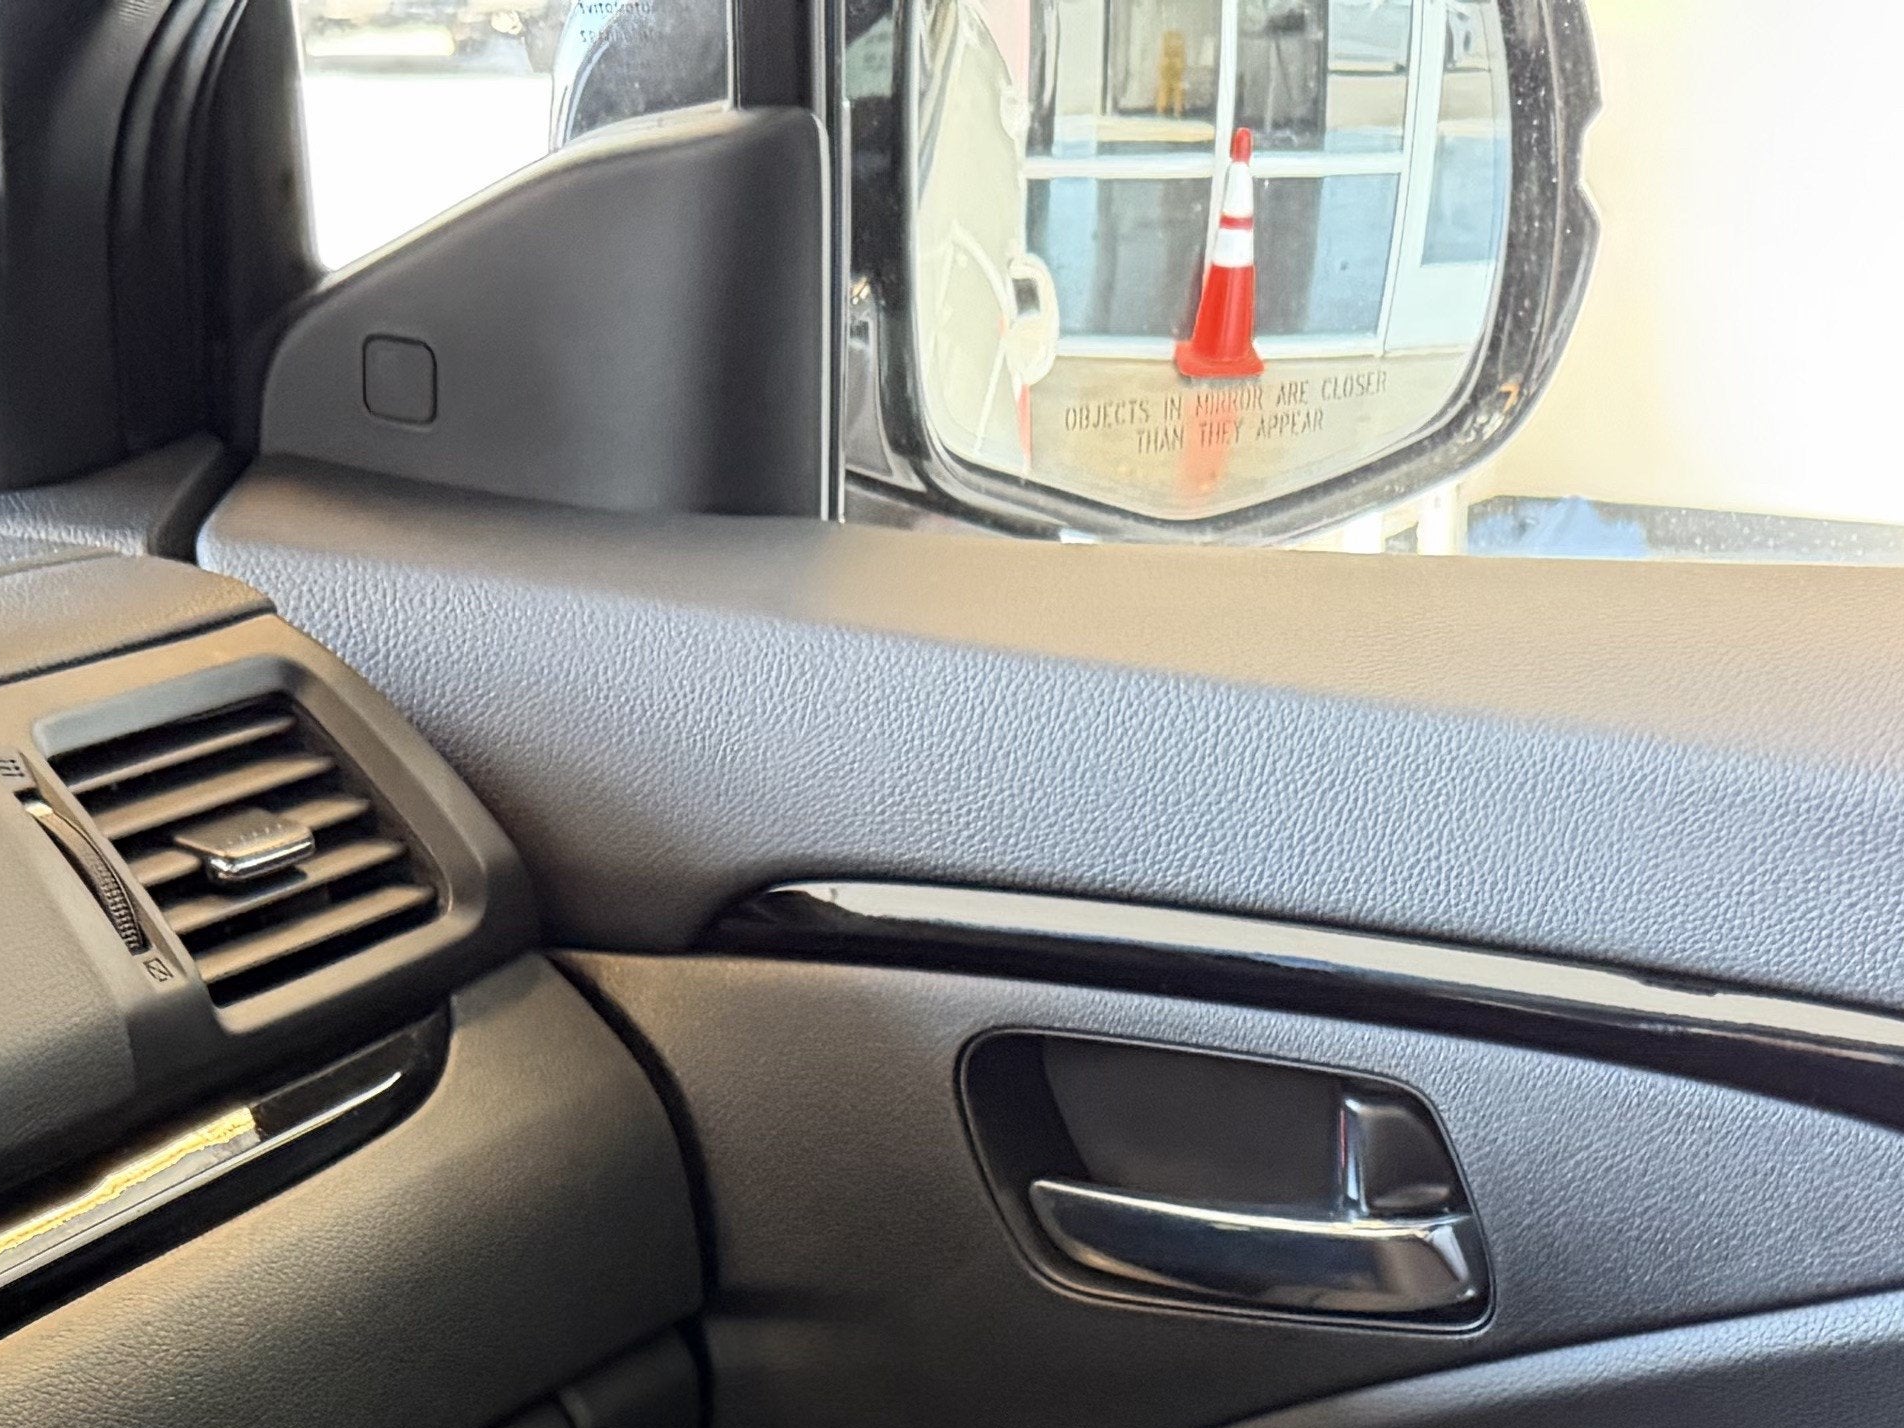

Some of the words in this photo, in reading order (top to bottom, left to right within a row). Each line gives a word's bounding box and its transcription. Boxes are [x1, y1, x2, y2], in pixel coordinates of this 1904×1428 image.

[1064, 400, 1149, 431] OBJECTS
[1163, 396, 1183, 420] IN
[1195, 384, 1264, 418] MIRROR
[1276, 381, 1310, 407] ARE
[1321, 370, 1388, 401] CLOSER
[1138, 424, 1185, 454] THAN
[1199, 419, 1243, 448] THEY
[1256, 408, 1325, 442] APPEAR
